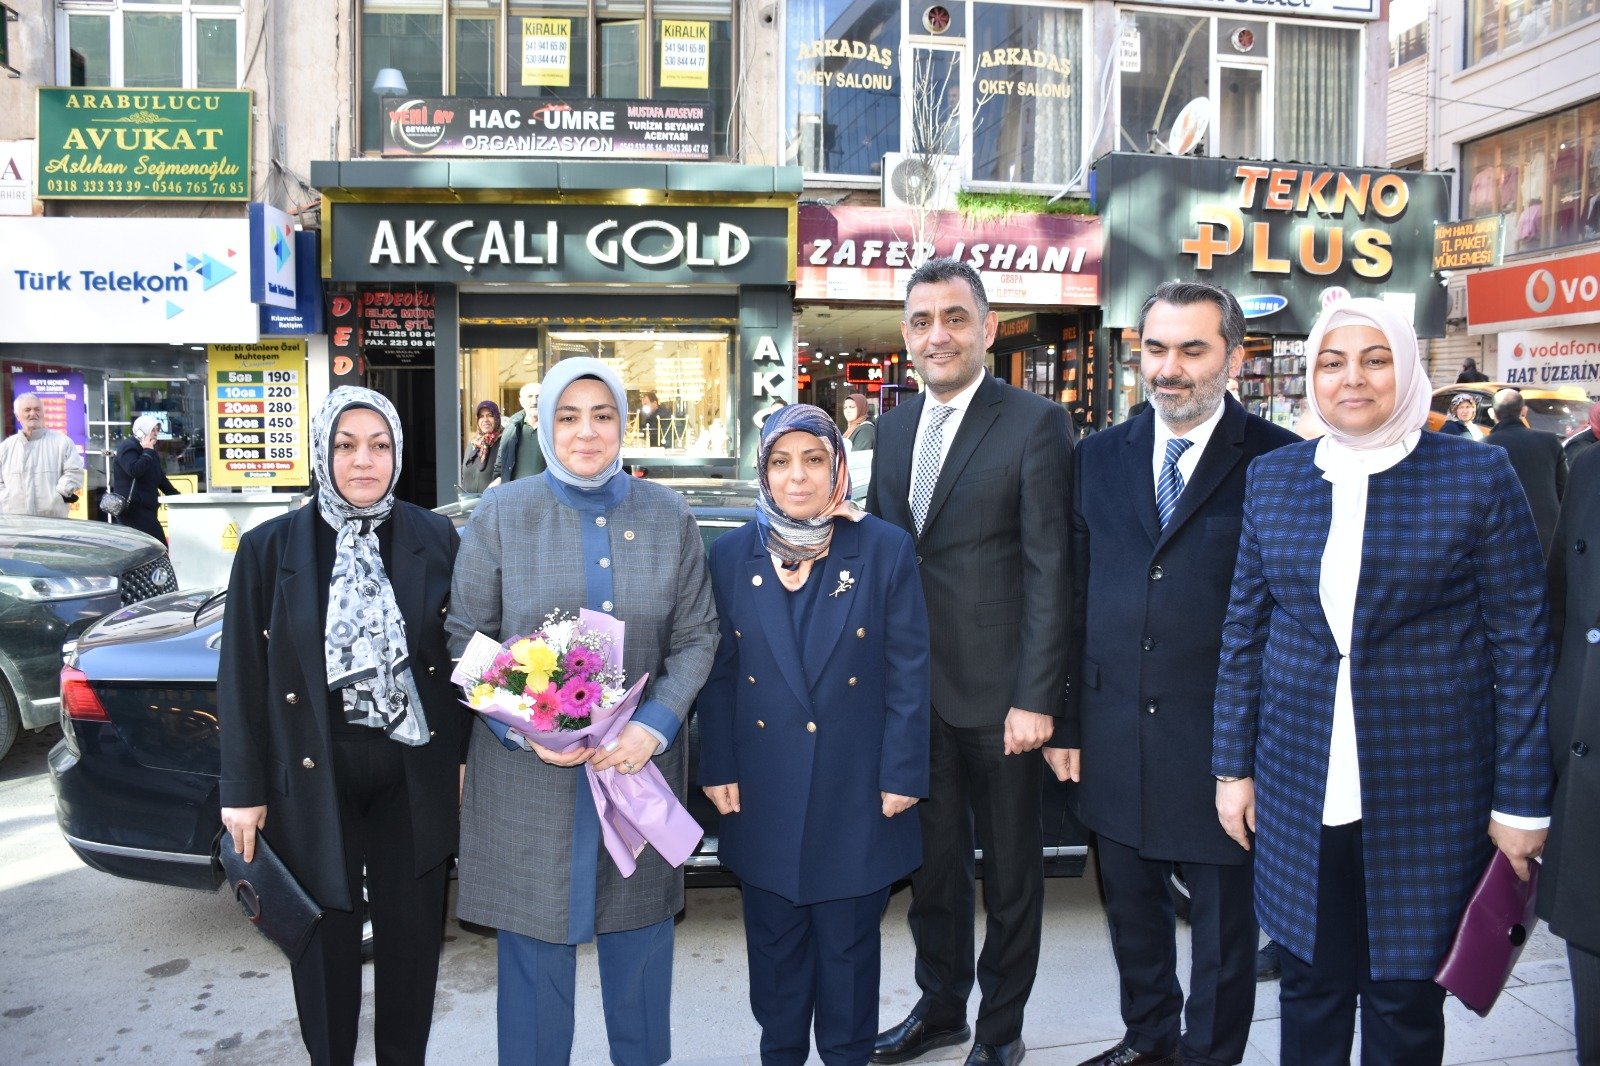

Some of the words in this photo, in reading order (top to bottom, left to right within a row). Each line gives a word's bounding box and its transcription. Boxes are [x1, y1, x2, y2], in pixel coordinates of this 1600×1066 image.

[525, 41, 537, 51] 541
[538, 41, 550, 51] 941
[550, 41, 558, 51] 65
[664, 42, 676, 52] 541
[677, 43, 688, 52] 941
[689, 43, 697, 53] 65
[525, 55, 537, 64] 530
[538, 55, 550, 65] 844
[550, 55, 558, 65] 44
[559, 56, 567, 65] 77
[796, 39, 892, 70] ARKADAŞ
[664, 56, 676, 66] 530
[677, 57, 688, 66] 844
[689, 57, 697, 66] 44
[698, 57, 706, 67] 77
[980, 47, 1071, 78] ARKADAŞ
[796, 71, 833, 86] OKEY
[836, 72, 892, 90] SALONU
[979, 79, 1014, 95] OKEY
[1017, 81, 1071, 99] SALONU
[65, 94, 220, 110] ARABULUCU
[389, 106, 428, 125] YENİ
[433, 110, 454, 124] AY
[469, 109, 521, 129] HAC
[543, 109, 615, 130] UMRE
[627, 107, 664, 118] MUSTAFA
[665, 107, 704, 119] ATASEVEN
[628, 120, 663, 131] TURİZM
[664, 121, 705, 132] SEYAHAT
[62, 128, 223, 150] AVUKAT
[462, 133, 613, 151] ORGANİZASYON
[644, 132, 689, 141] ACENTASI
[45, 154, 127, 175] Aslıhan
[133, 155, 239, 181] Seğmenoğlu
[48, 179, 77, 192] 0318
[152, 181, 182, 193] 0546
[186, 182, 208, 194] 765
[212, 182, 226, 194] 76
[230, 182, 244, 194] 85
[1235, 165, 1409, 218] TEKNO
[369, 220, 559, 272] AKÇALI
[586, 219, 750, 267] GOLD
[1441, 240, 1453, 252] TL
[1454, 235, 1488, 252] PAKET
[14, 269, 71, 291] Türk
[80, 270, 188, 292] Telekom
[370, 319, 402, 330] LTD.
[281, 342, 300, 351] Özel
[234, 353, 280, 361] Muhteşem
[228, 371, 252, 383] 5GB
[267, 371, 291, 382] 190
[1507, 367, 1537, 383] HAT
[225, 387, 256, 398] 10GB
[267, 387, 292, 397] 220
[224, 402, 258, 413] 20GB
[268, 402, 292, 413] 280
[224, 417, 259, 428] 40GB
[268, 417, 293, 428] 450
[225, 433, 259, 444] 60GB
[270, 432, 293, 443] 525
[225, 448, 260, 459] 80GB
[270, 448, 293, 458] 585
